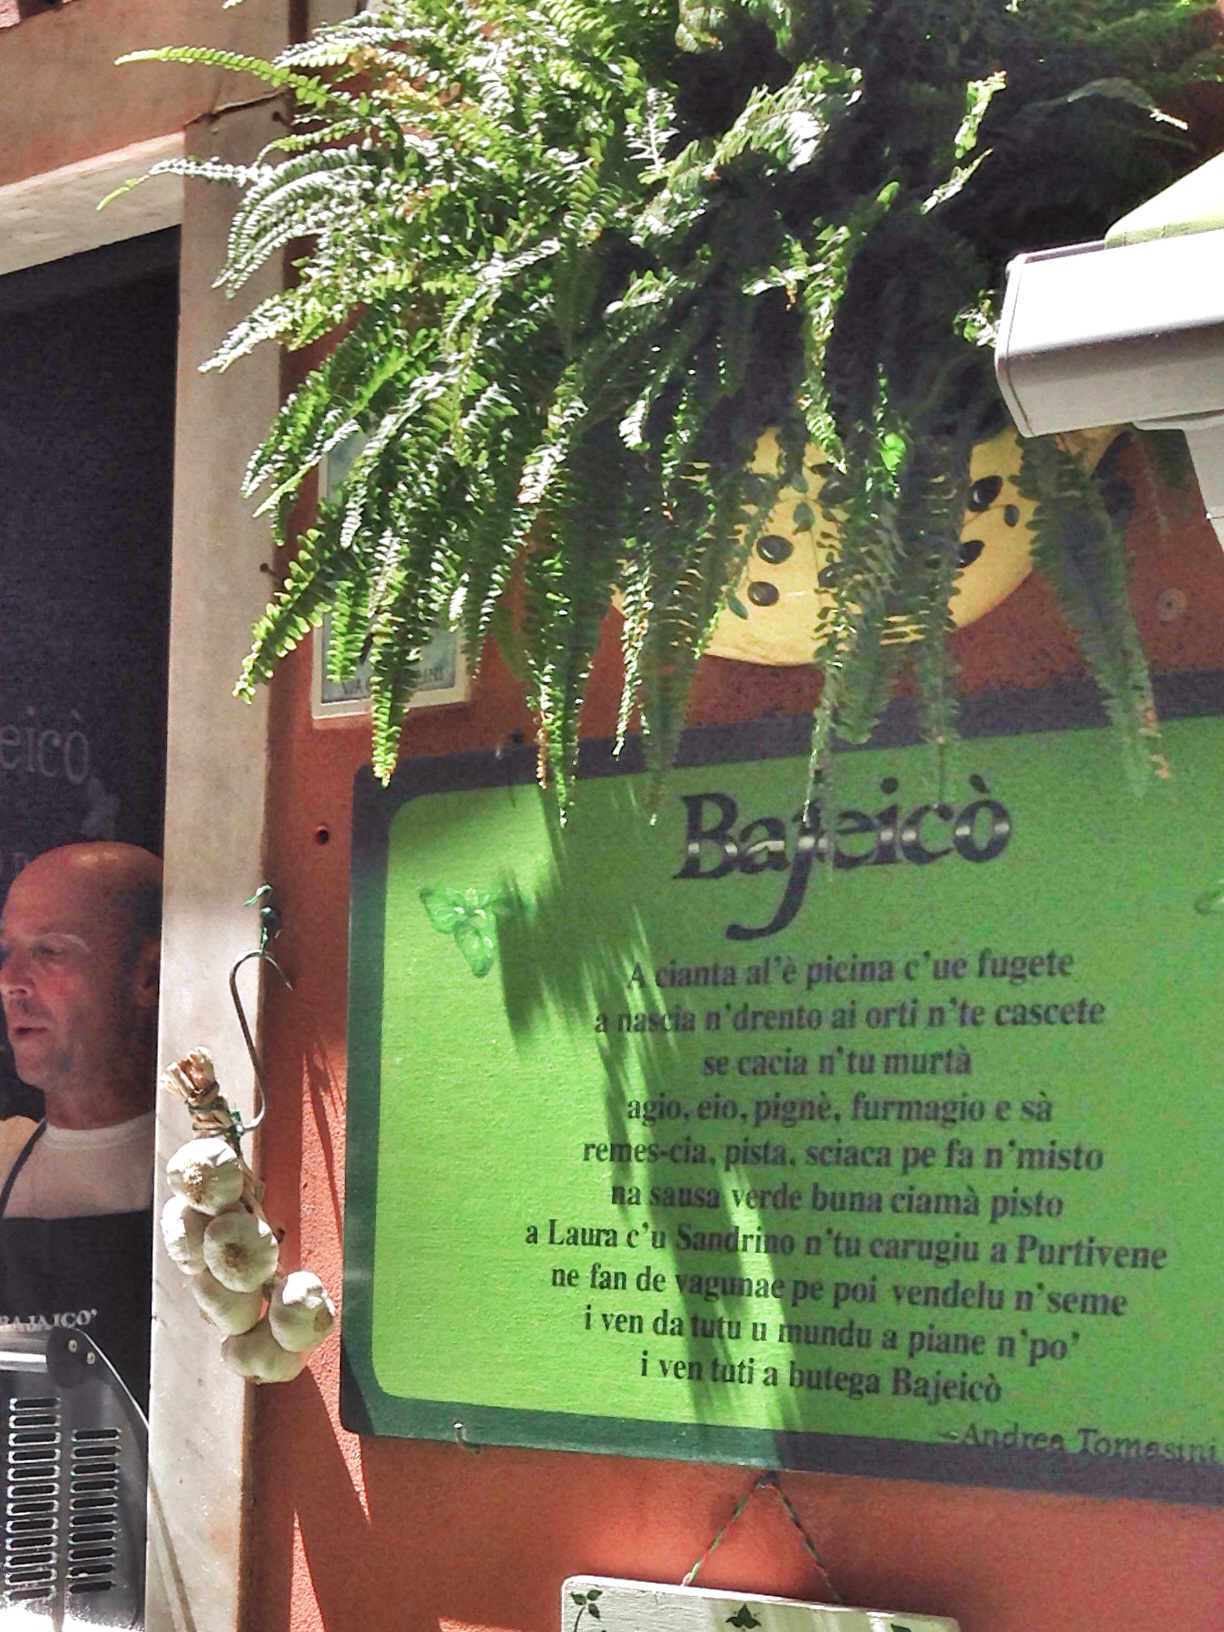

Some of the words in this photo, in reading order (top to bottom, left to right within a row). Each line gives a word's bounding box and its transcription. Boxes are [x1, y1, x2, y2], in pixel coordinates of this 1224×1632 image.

[672, 774, 1012, 941] Bajeicò
[627, 964, 645, 989] A
[655, 958, 737, 988] cianta
[805, 953, 894, 991] picina
[978, 947, 1074, 985] fugete
[594, 1013, 609, 1033] a
[831, 1000, 857, 1030] ai
[865, 997, 918, 1029] orti
[994, 997, 1106, 1027] cascete
[702, 1054, 729, 1076] se
[738, 1047, 808, 1075] cacia
[883, 1044, 972, 1075] murtà
[850, 1089, 985, 1129] furmagio
[994, 1100, 1011, 1122] e
[1021, 1089, 1053, 1122] sà
[901, 1145, 936, 1175] pe
[945, 1138, 974, 1168] fa
[610, 1184, 642, 1206] na
[649, 1184, 721, 1209] sausa
[731, 1181, 803, 1210] verde
[810, 1181, 883, 1213] buna
[890, 1184, 980, 1216] ciamà
[989, 1185, 1064, 1224] pisto
[525, 1223, 539, 1245] a
[548, 1219, 618, 1248] Laura
[676, 1222, 795, 1256] Sandrino
[869, 1231, 980, 1268] carugiu
[989, 1241, 1007, 1264] a
[1015, 1233, 1168, 1271] Purtivene
[551, 1267, 579, 1288] ne
[589, 1262, 627, 1291] fan
[636, 1265, 666, 1293] de
[791, 1278, 824, 1307] pe
[833, 1274, 878, 1310] poi
[891, 1279, 1005, 1310] vendelu
[585, 1304, 592, 1331] i
[601, 1312, 644, 1334] ven
[653, 1308, 684, 1337] da
[691, 1314, 742, 1340] tutu
[751, 1321, 768, 1342] u
[778, 1318, 872, 1349] mundu
[881, 1328, 898, 1350] a
[908, 1323, 986, 1359] piane
[641, 1350, 648, 1378] i
[659, 1358, 704, 1382] ven
[710, 1356, 755, 1384] tuti
[762, 1366, 779, 1388] a
[789, 1360, 881, 1401] butega
[891, 1366, 1002, 1406] Bajeicò
[961, 1422, 1066, 1451] Andrea
